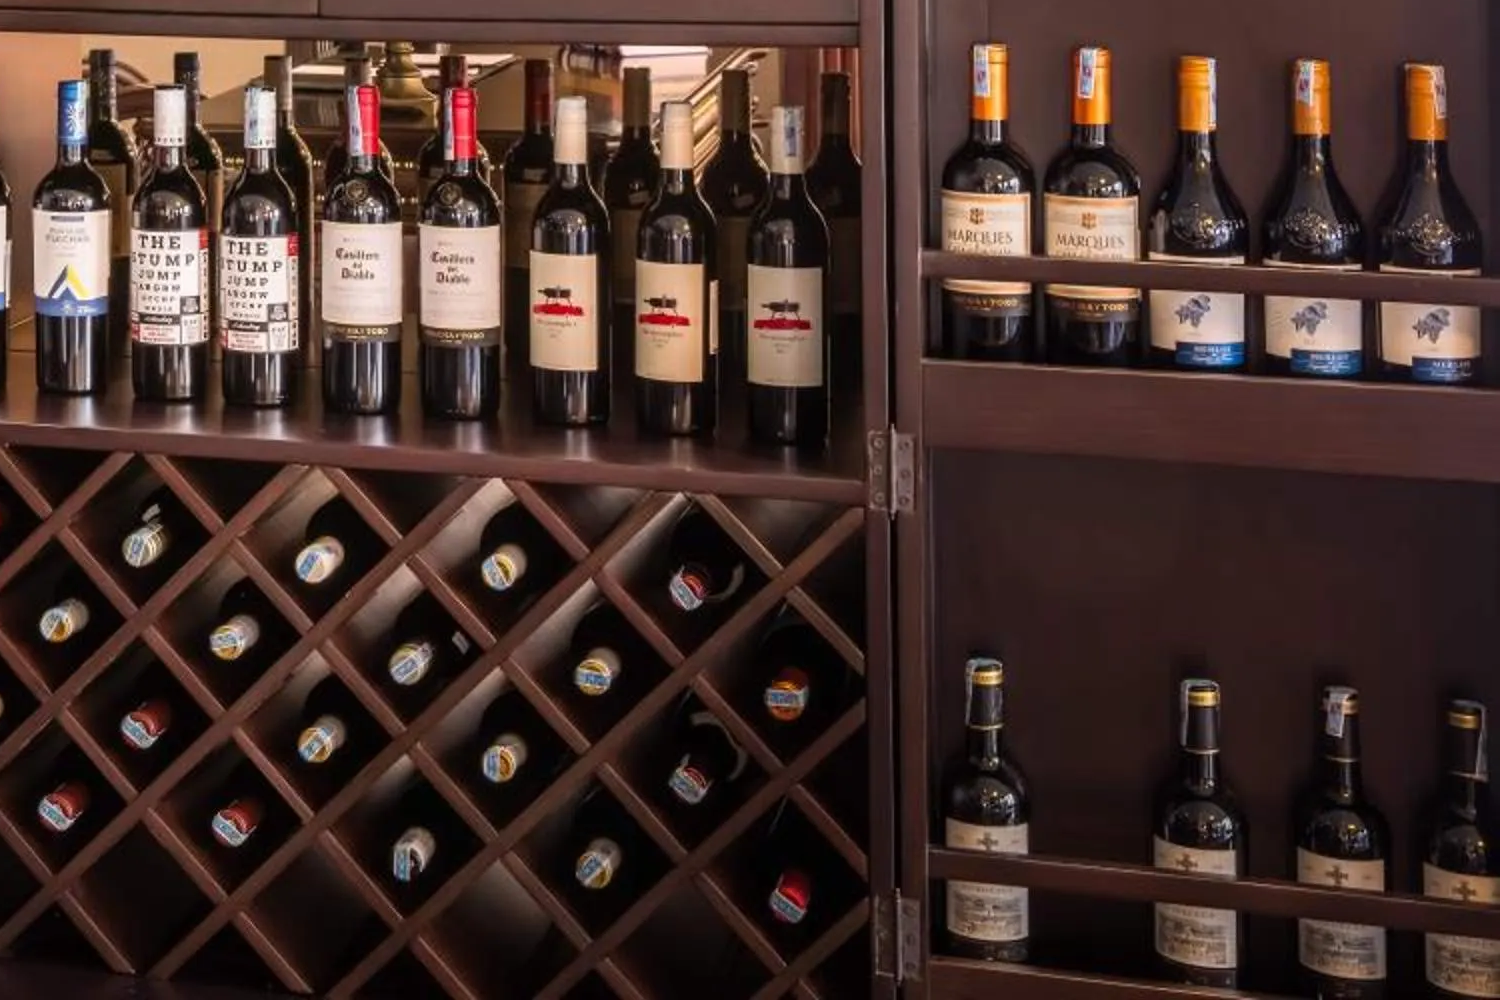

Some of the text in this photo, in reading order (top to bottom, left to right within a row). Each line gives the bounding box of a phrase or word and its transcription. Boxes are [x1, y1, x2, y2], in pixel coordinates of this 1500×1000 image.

[138, 234, 181, 249] THE
[947, 229, 1013, 244] MARQUES
[1056, 232, 1125, 249] MARQUES
[227, 239, 268, 256] THE
[139, 270, 181, 281] JUMP
[227, 275, 269, 287] JUMP
